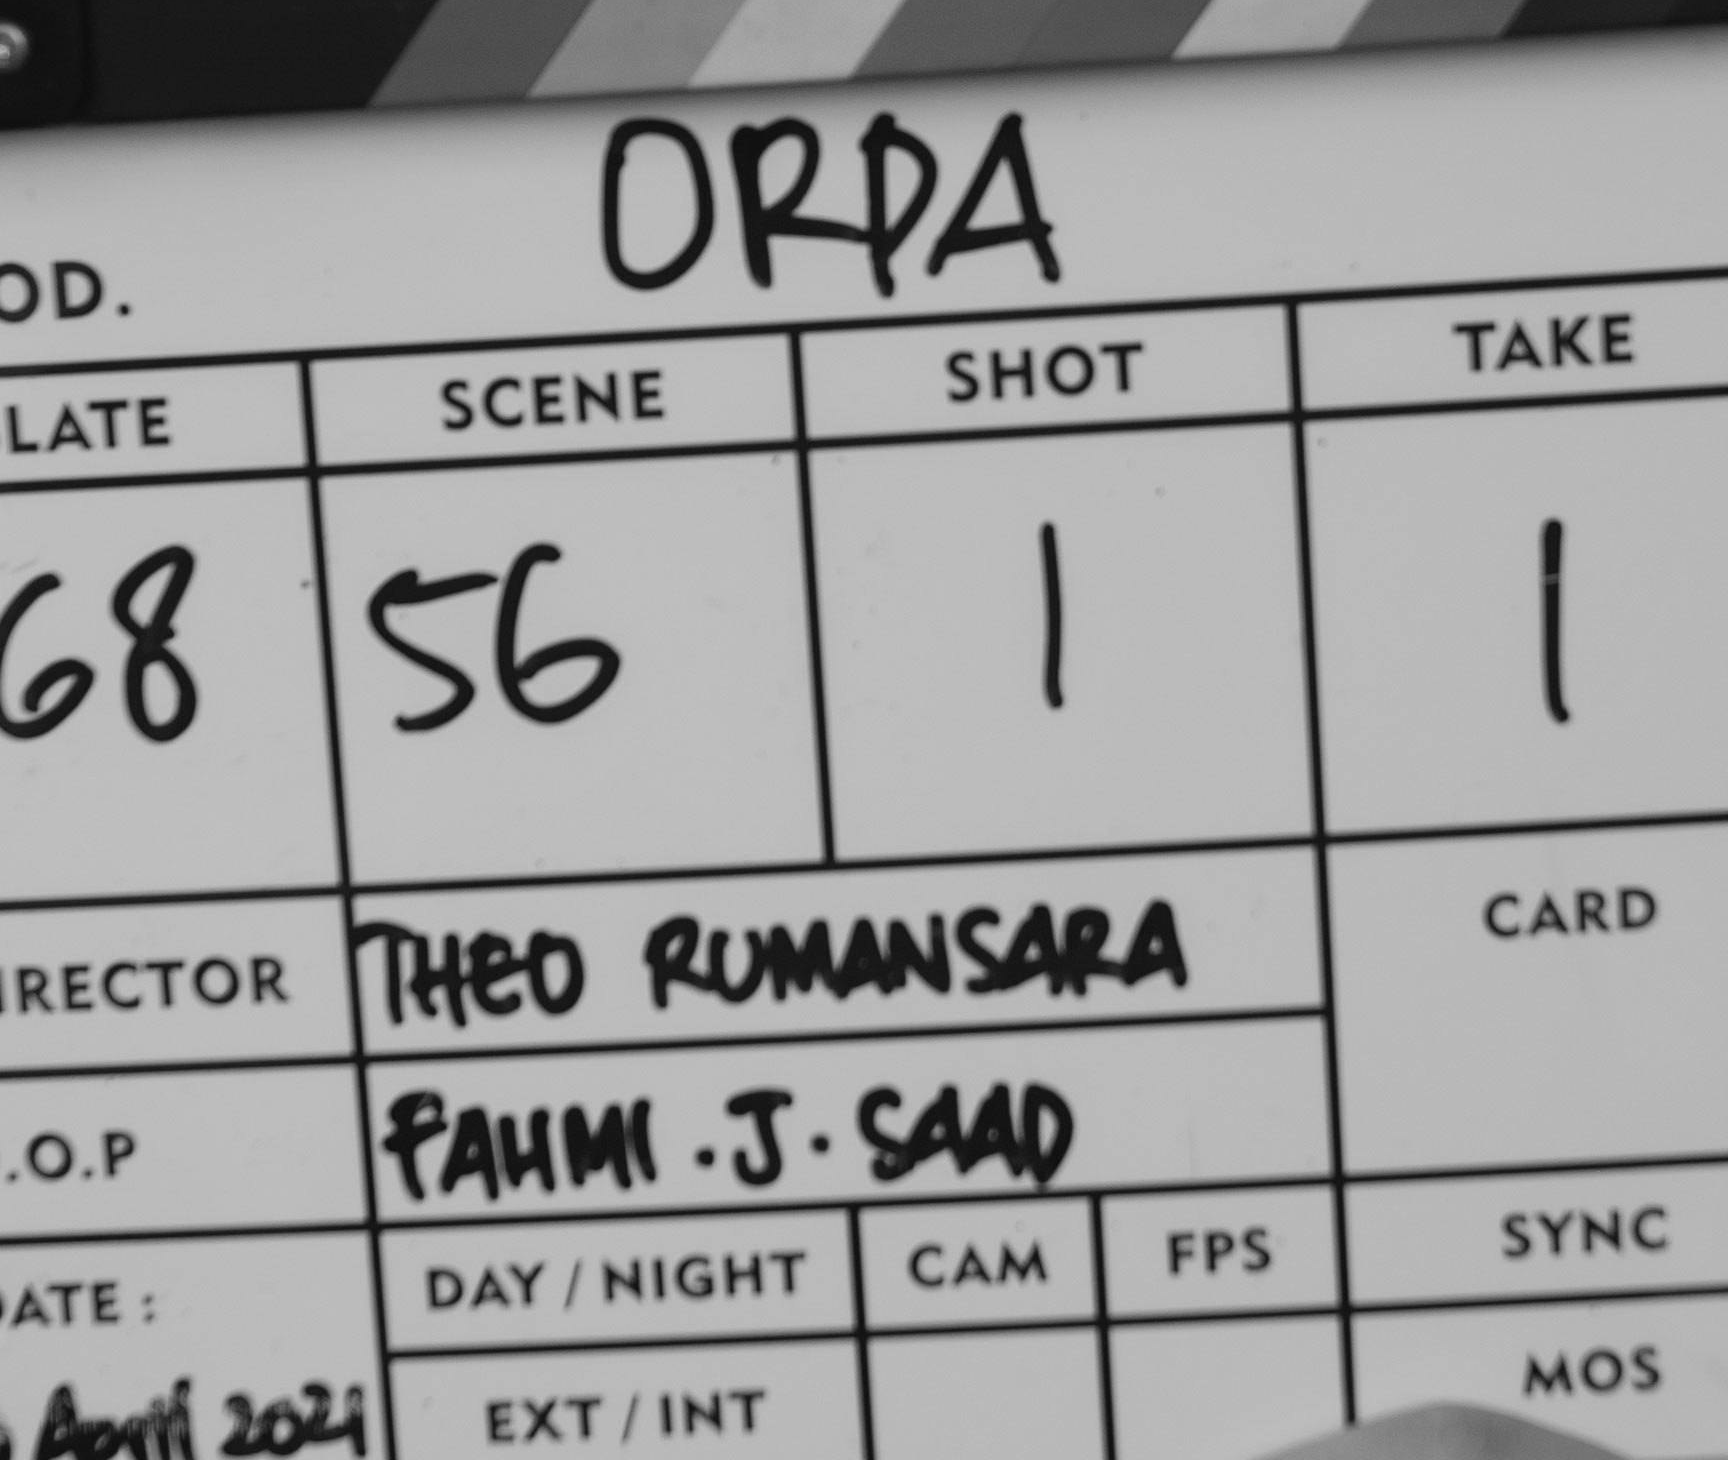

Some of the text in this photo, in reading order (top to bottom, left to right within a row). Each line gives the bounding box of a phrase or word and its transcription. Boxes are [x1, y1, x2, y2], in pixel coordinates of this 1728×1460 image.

[599, 111, 1063, 299] ORPA
[944, 340, 1146, 405] SHOT
[1451, 311, 1636, 374] TAKE
[439, 368, 666, 433] SCENE
[364, 541, 623, 735] 56
[1038, 520, 1066, 711] 1
[1538, 516, 1572, 726] 1
[1482, 885, 1659, 940] CARD
[354, 898, 1189, 1027] THEO RUMANSARA
[381, 1090, 657, 1201] FAHMI
[855, 1081, 1074, 1194] SAAD
[906, 1241, 1050, 1290] CAM
[1166, 1226, 1273, 1277] FPS
[1500, 1205, 1668, 1261] SYNC
[1522, 1344, 1663, 1397] MOS
